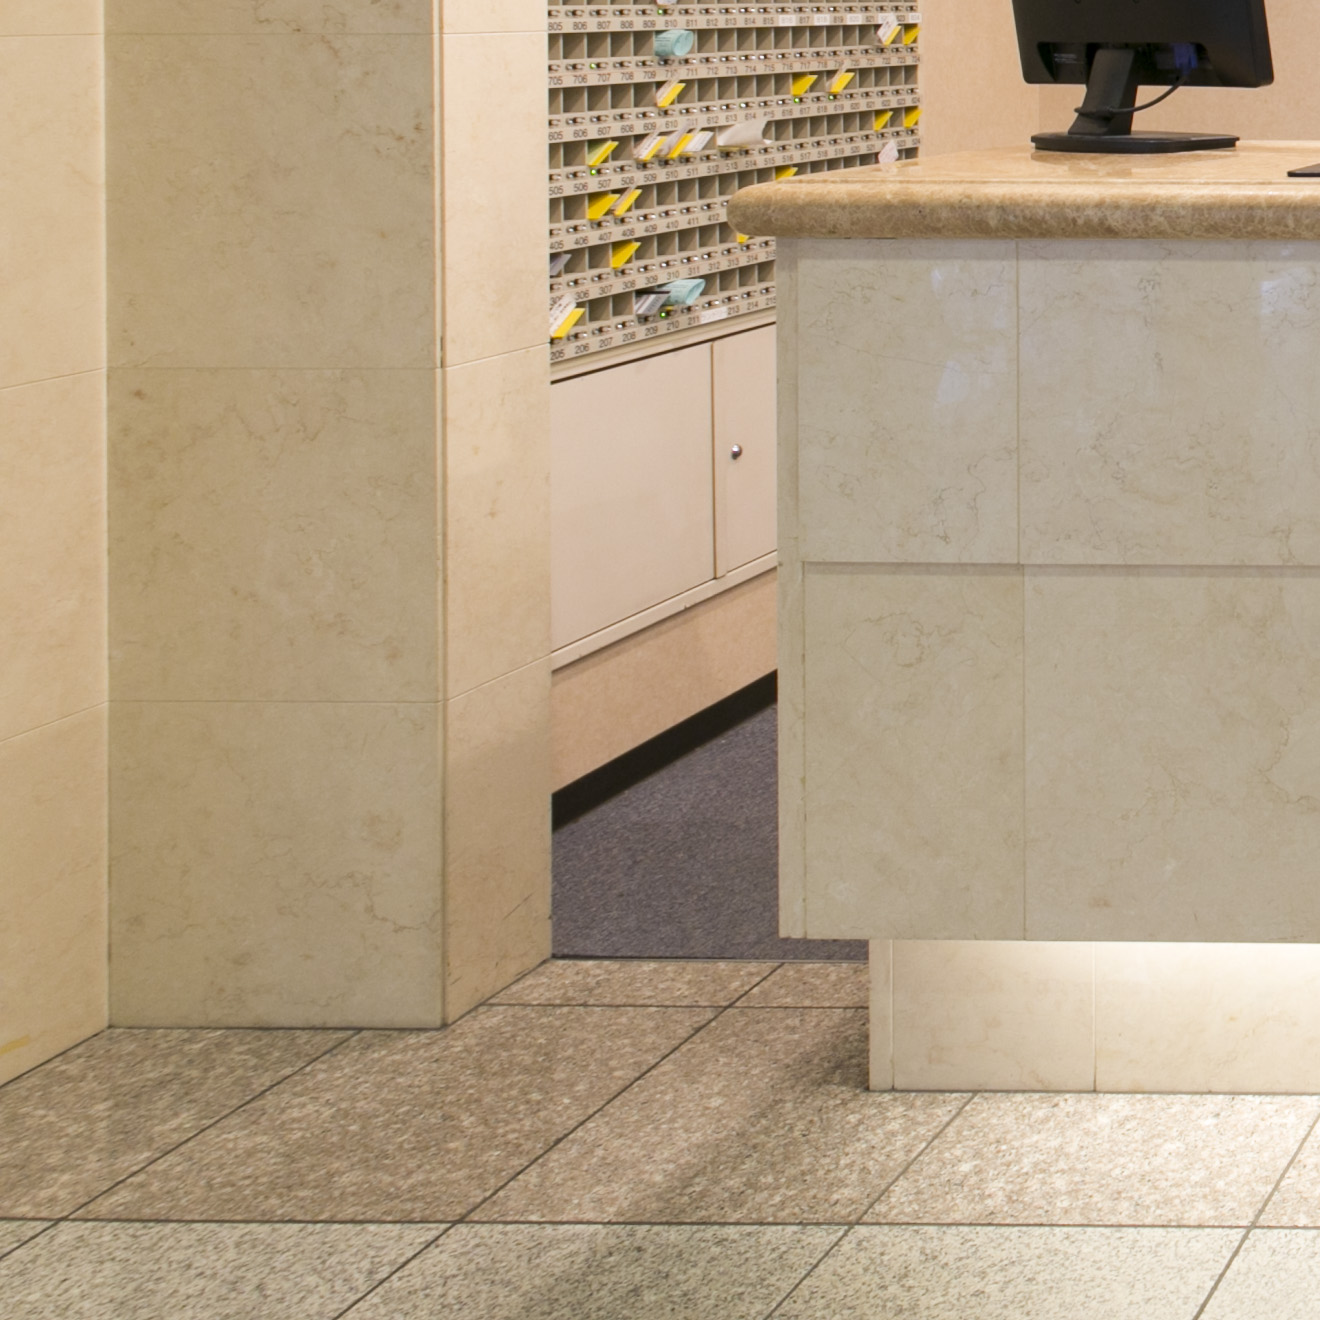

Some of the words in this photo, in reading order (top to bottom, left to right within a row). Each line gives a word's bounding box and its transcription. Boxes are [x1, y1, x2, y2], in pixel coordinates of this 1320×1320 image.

[548, 21, 564, 31] 805
[572, 20, 588, 30] 806
[596, 20, 612, 29] 807
[619, 20, 634, 29] 808
[642, 19, 656, 28] 809
[664, 19, 678, 27] 810
[685, 18, 699, 27] 811
[705, 18, 719, 26] 812
[725, 17, 738, 26] 813
[744, 17, 757, 25] 814
[548, 76, 564, 85] 705
[572, 74, 588, 83] 706
[596, 73, 612, 82] 707
[620, 71, 635, 80] 708
[642, 70, 657, 79] 709
[685, 67, 699, 76] 711
[705, 66, 719, 75] 712
[725, 65, 738, 74] 713
[744, 64, 757, 72] 714
[763, 63, 776, 71] 715
[548, 130, 565, 140] 605
[573, 127, 589, 138] 606
[597, 125, 612, 135] 607
[620, 123, 635, 133] 608
[642, 121, 657, 130] 609
[664, 119, 678, 128] 610
[706, 115, 719, 124] 612
[726, 113, 739, 122] 613
[745, 111, 758, 120] 614
[548, 184, 565, 195] 505
[573, 181, 589, 192] 506
[597, 178, 613, 188] 507
[620, 175, 636, 185] 508
[643, 172, 658, 182] 509
[664, 169, 679, 179] 510
[686, 166, 700, 176] 511
[706, 164, 720, 173] 512
[726, 161, 739, 170] 513
[745, 158, 758, 168] 514
[764, 156, 776, 165] 515
[548, 240, 565, 250] 405
[573, 235, 590, 246] 406
[597, 231, 613, 242] 407
[620, 227, 636, 237] 408
[643, 223, 658, 233] 409
[665, 220, 679, 229] 410
[686, 216, 700, 226] 411
[706, 213, 720, 222] 412
[574, 288, 590, 300] 306
[598, 283, 613, 295] 307
[621, 279, 636, 290] 308
[643, 274, 658, 285] 309
[665, 269, 679, 280] 310
[686, 265, 700, 275] 311
[707, 261, 720, 271] 312
[726, 256, 740, 266] 313
[746, 252, 758, 262] 314
[549, 348, 566, 360] 205
[574, 342, 590, 354] 206
[598, 336, 614, 348] 207
[621, 330, 636, 342] 208
[644, 325, 658, 336] 209
[665, 319, 680, 330] 210
[686, 314, 700, 325] 211
[727, 304, 740, 315] 213
[746, 300, 759, 310] 214
